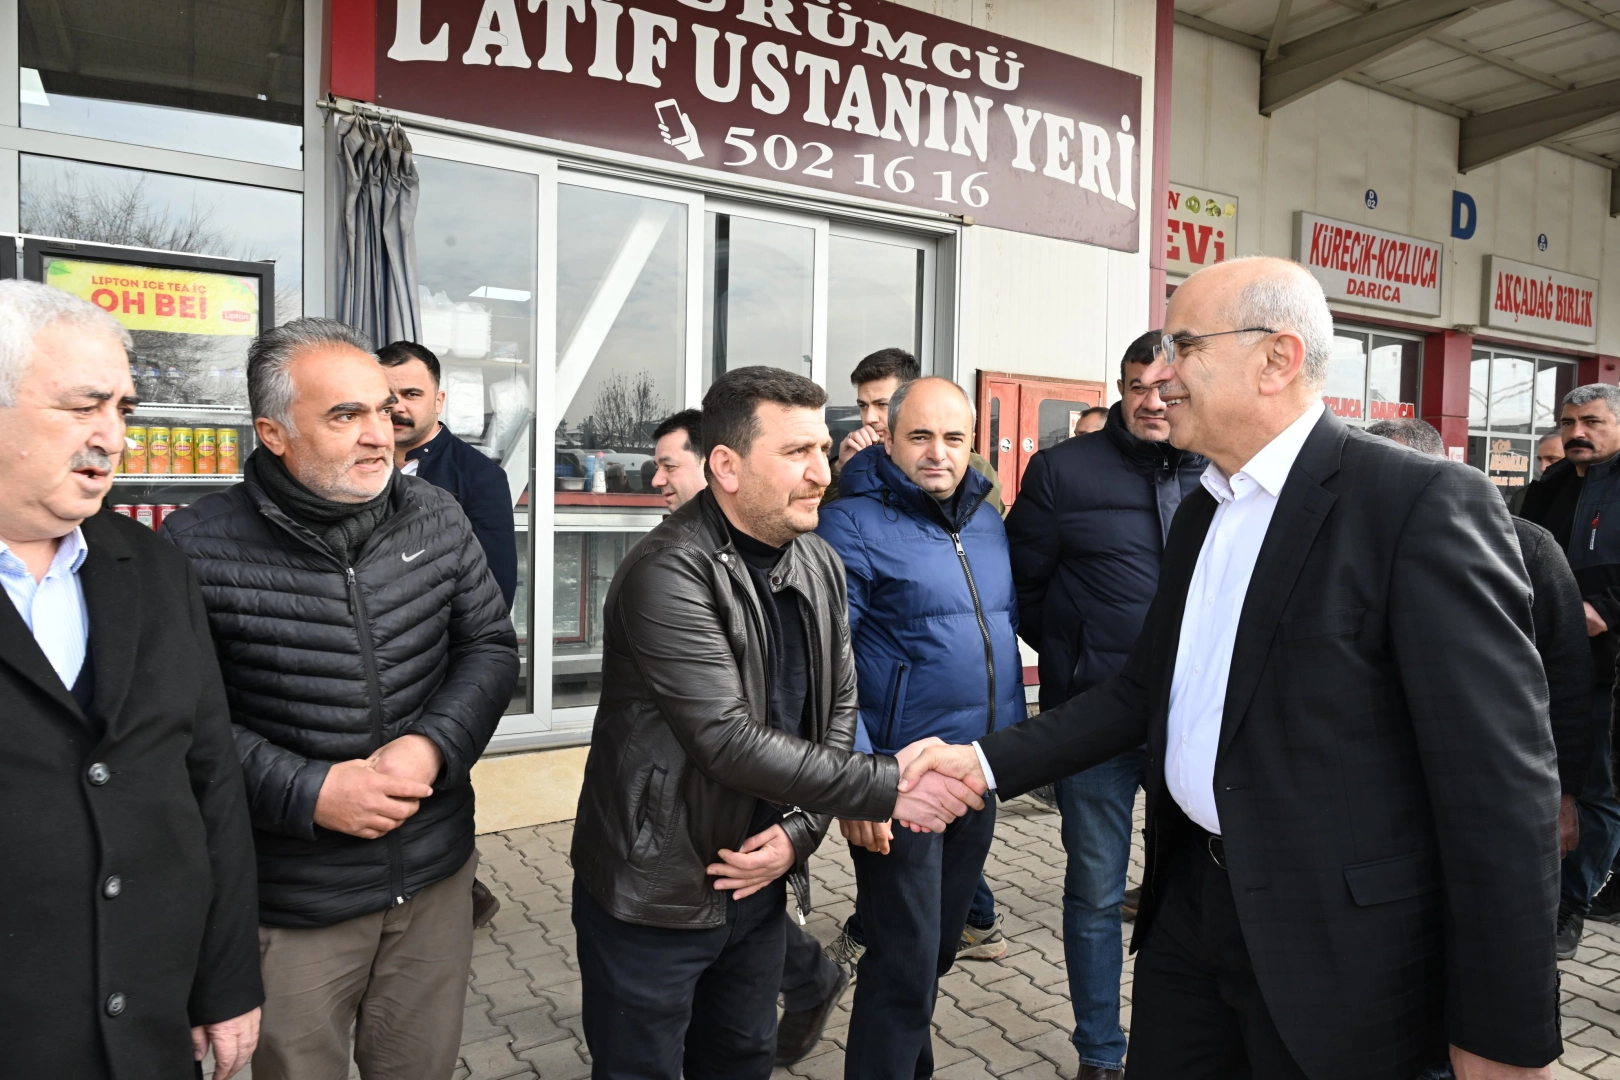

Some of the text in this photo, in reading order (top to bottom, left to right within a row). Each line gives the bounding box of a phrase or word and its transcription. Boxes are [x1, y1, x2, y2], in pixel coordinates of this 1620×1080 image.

[691, 23, 993, 162] USTANIN
[1003, 103, 1136, 210] YERİ
[723, 126, 990, 208] 502 16 16
[1367, 199, 1376, 208] 02
[1369, 190, 1375, 199] D
[1450, 190, 1477, 240] D
[91, 275, 139, 288] LIPTON
[143, 280, 165, 290] ICE
[167, 283, 190, 293] TEA
[1346, 278, 1401, 303] DARICA
[1494, 271, 1554, 323] AKÇADAĞ
[91, 288, 207, 319] OH BE!
[224, 312, 249, 321] Lipton
